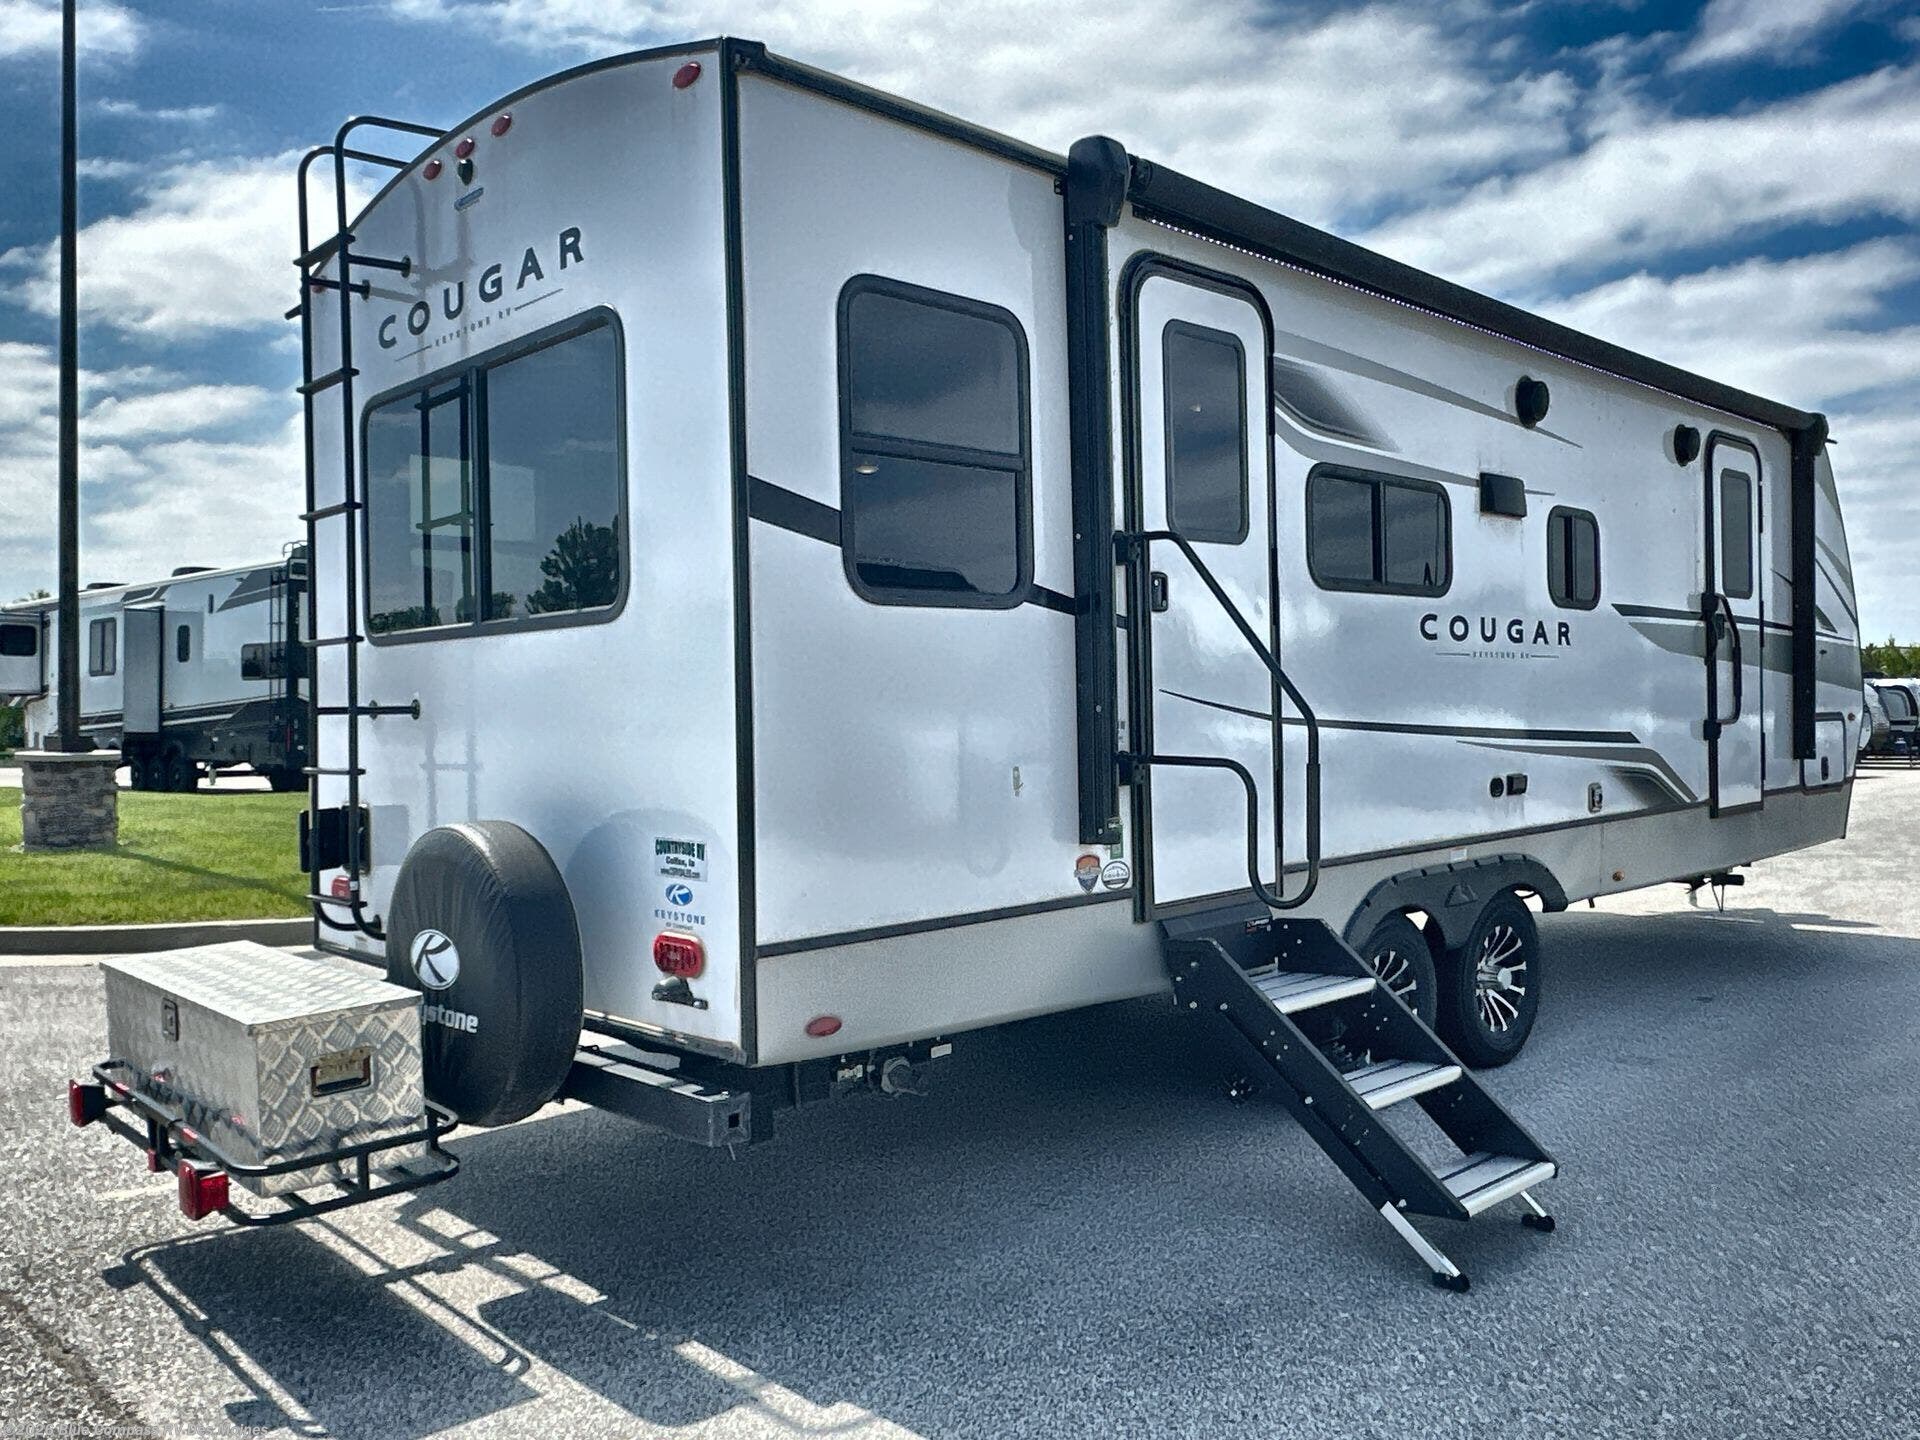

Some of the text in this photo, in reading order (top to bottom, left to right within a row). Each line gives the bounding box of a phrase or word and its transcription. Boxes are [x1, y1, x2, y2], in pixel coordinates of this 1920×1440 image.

[378, 226, 584, 349] COUGAR
[1419, 613, 1571, 646] COUGAR
[654, 909, 705, 926] KEYSTONE
